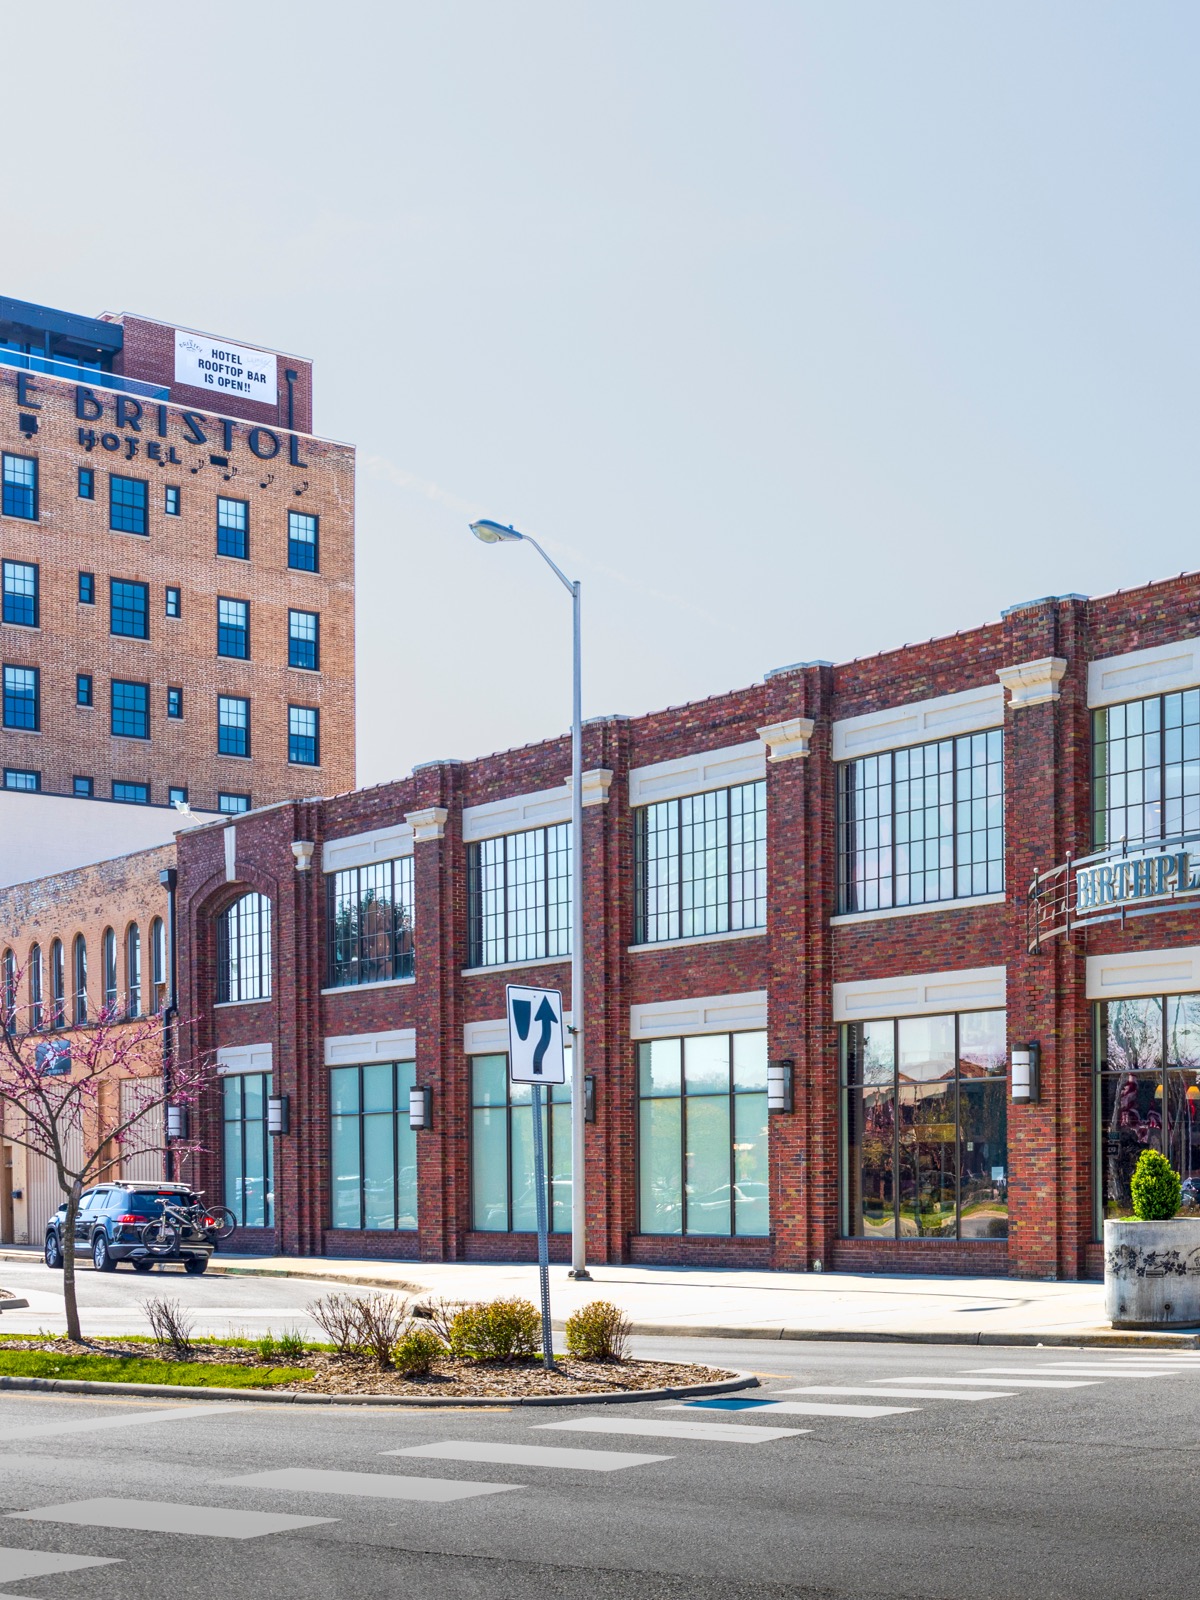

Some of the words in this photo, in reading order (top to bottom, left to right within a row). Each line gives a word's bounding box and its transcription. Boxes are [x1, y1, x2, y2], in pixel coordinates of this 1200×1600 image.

[211, 349, 243, 365] HOTEL
[198, 358, 243, 378] ROOFTOP
[247, 371, 266, 384] BAR
[204, 373, 214, 384] IS
[217, 376, 251, 393] OPEN!!
[76, 385, 309, 468] BRISTOL
[78, 427, 182, 465] HOTEL
